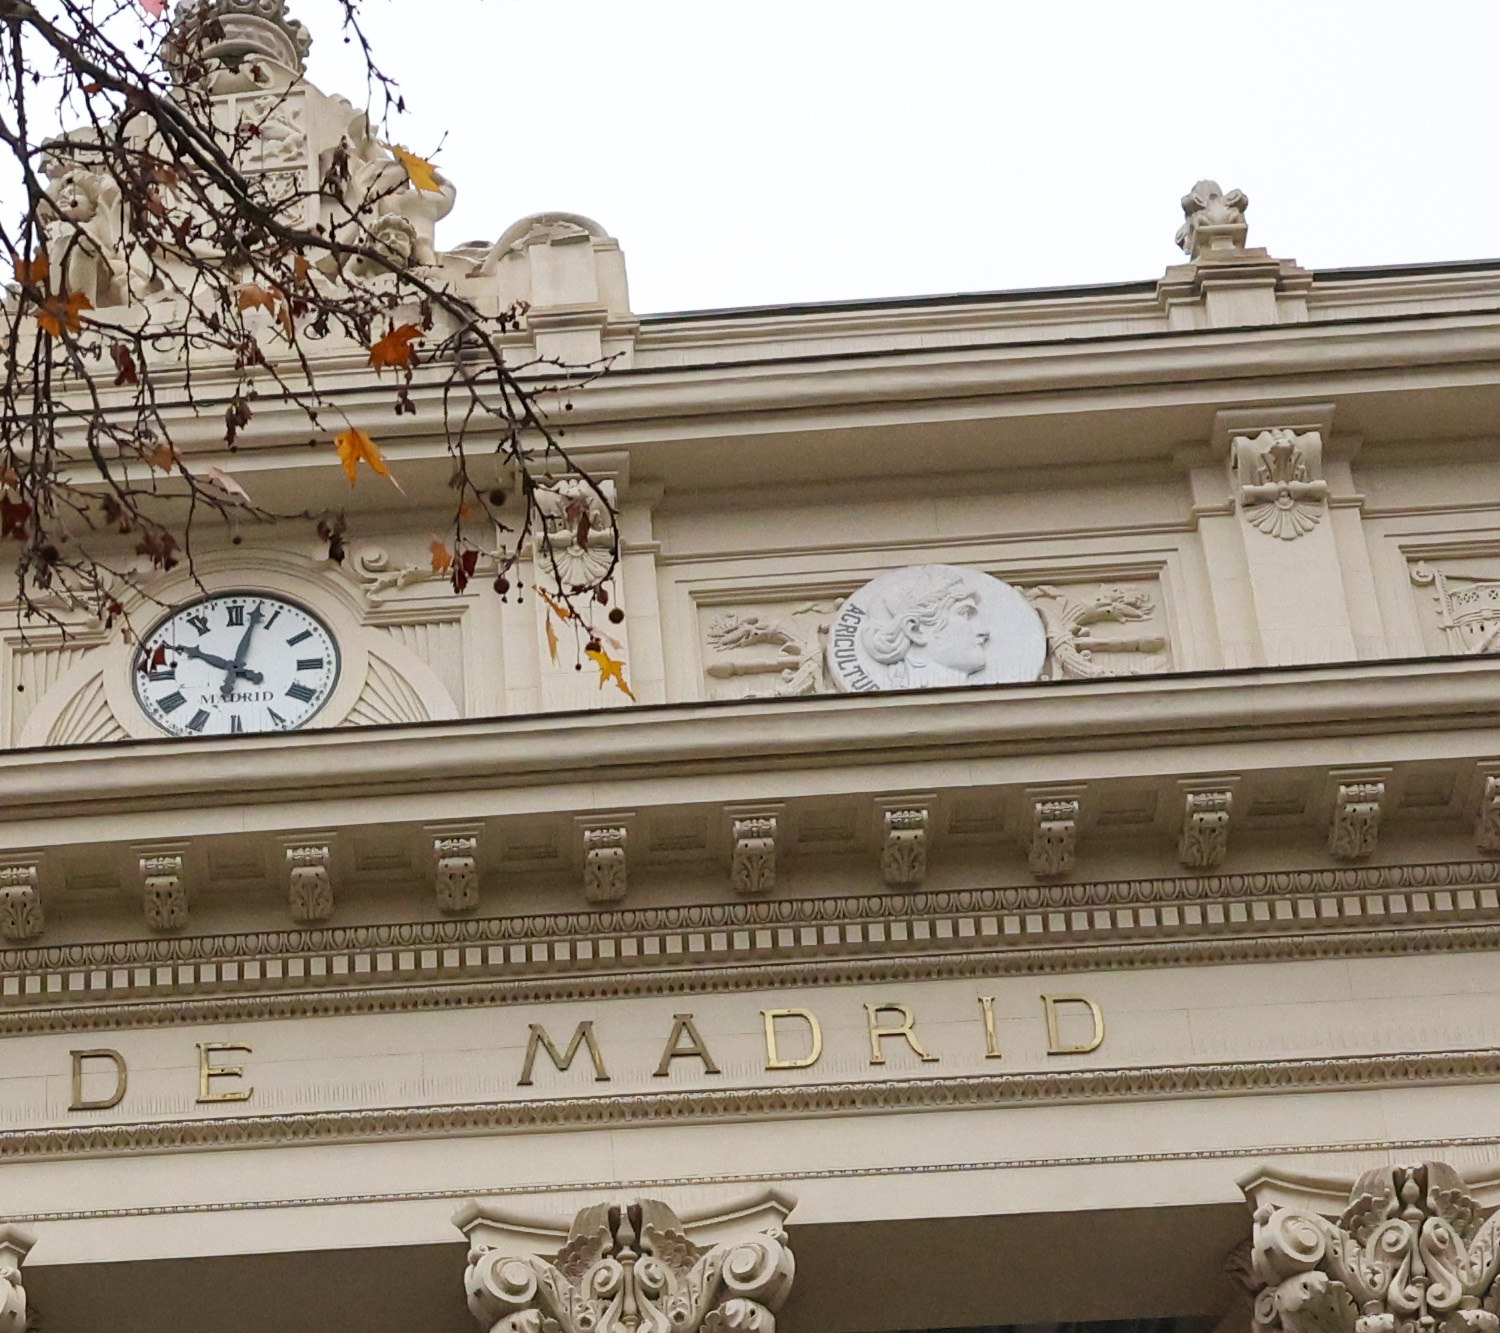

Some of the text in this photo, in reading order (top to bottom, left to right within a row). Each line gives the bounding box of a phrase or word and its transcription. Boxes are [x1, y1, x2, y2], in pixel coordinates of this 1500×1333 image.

[200, 691, 274, 706] MADRID
[67, 1041, 254, 1112] DE
[517, 992, 1105, 1085] MADRID
